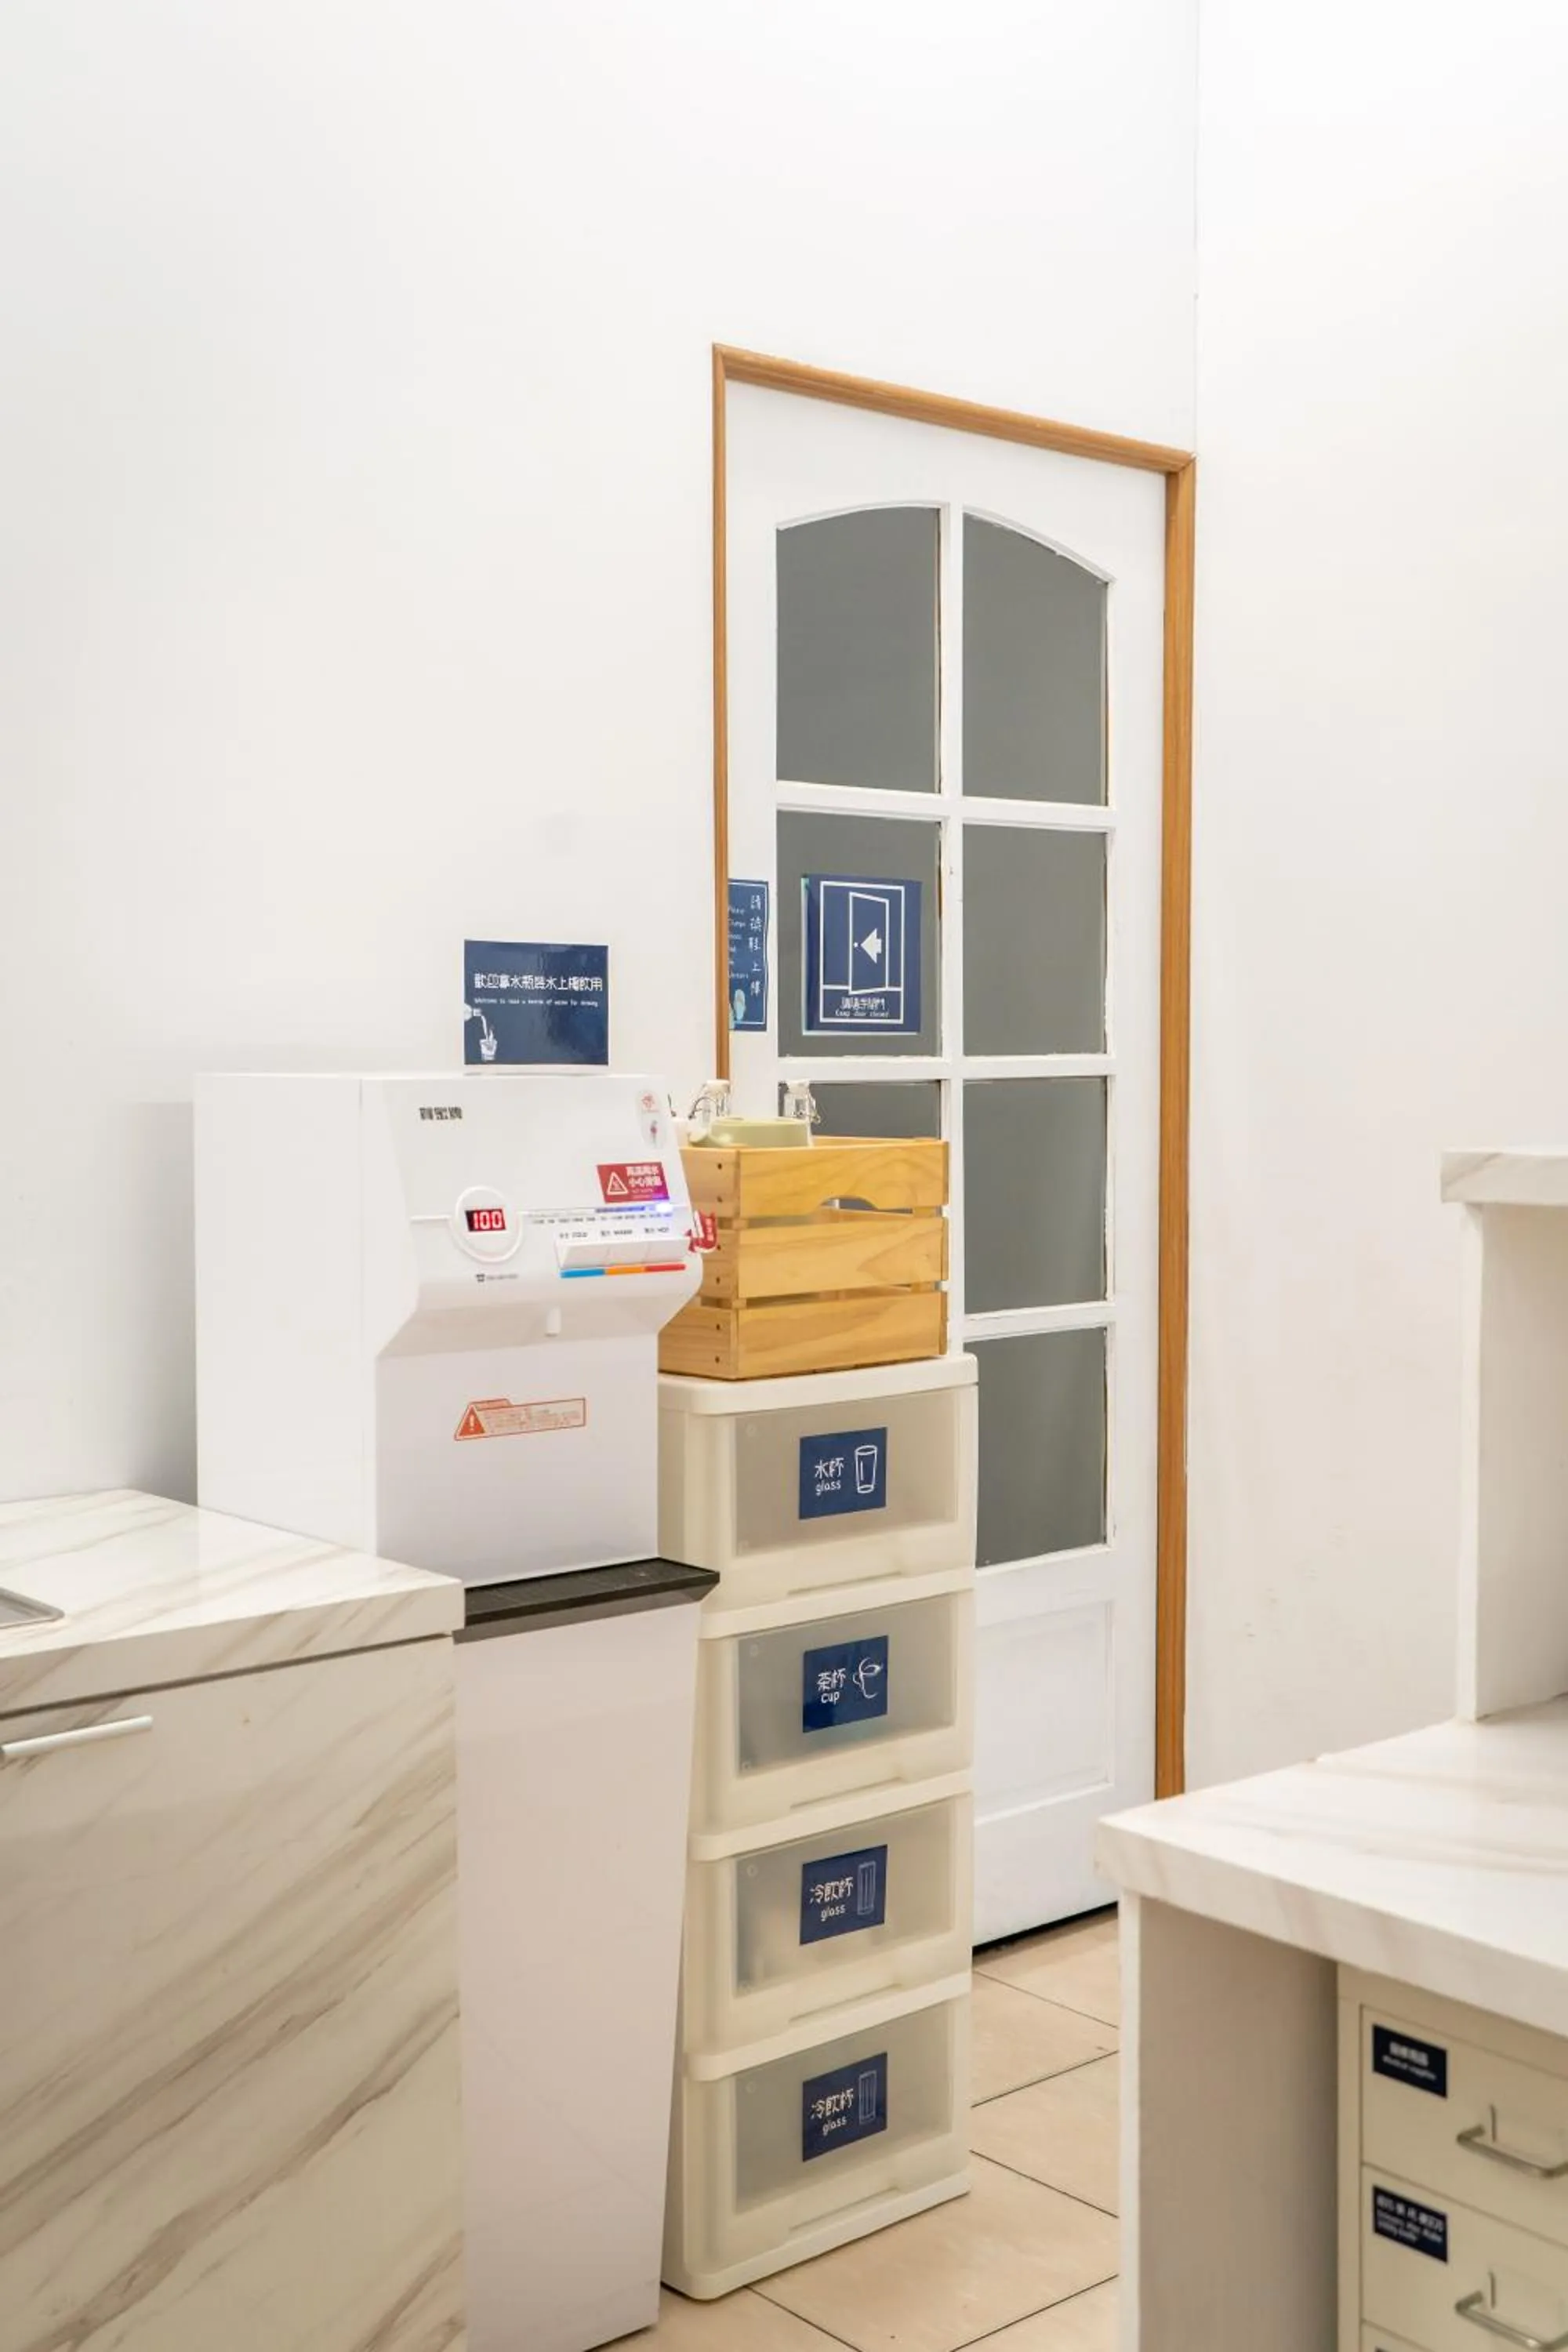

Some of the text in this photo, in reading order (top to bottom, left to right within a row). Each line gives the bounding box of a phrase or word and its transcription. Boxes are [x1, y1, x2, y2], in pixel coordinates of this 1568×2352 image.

[473, 1211, 503, 1229] 100
[814, 1457, 844, 1479] 水杯
[815, 1480, 841, 1497] glass
[816, 1668, 847, 1692] 茶杯
[820, 1904, 846, 1922] glass
[822, 2115, 848, 2136] glass
